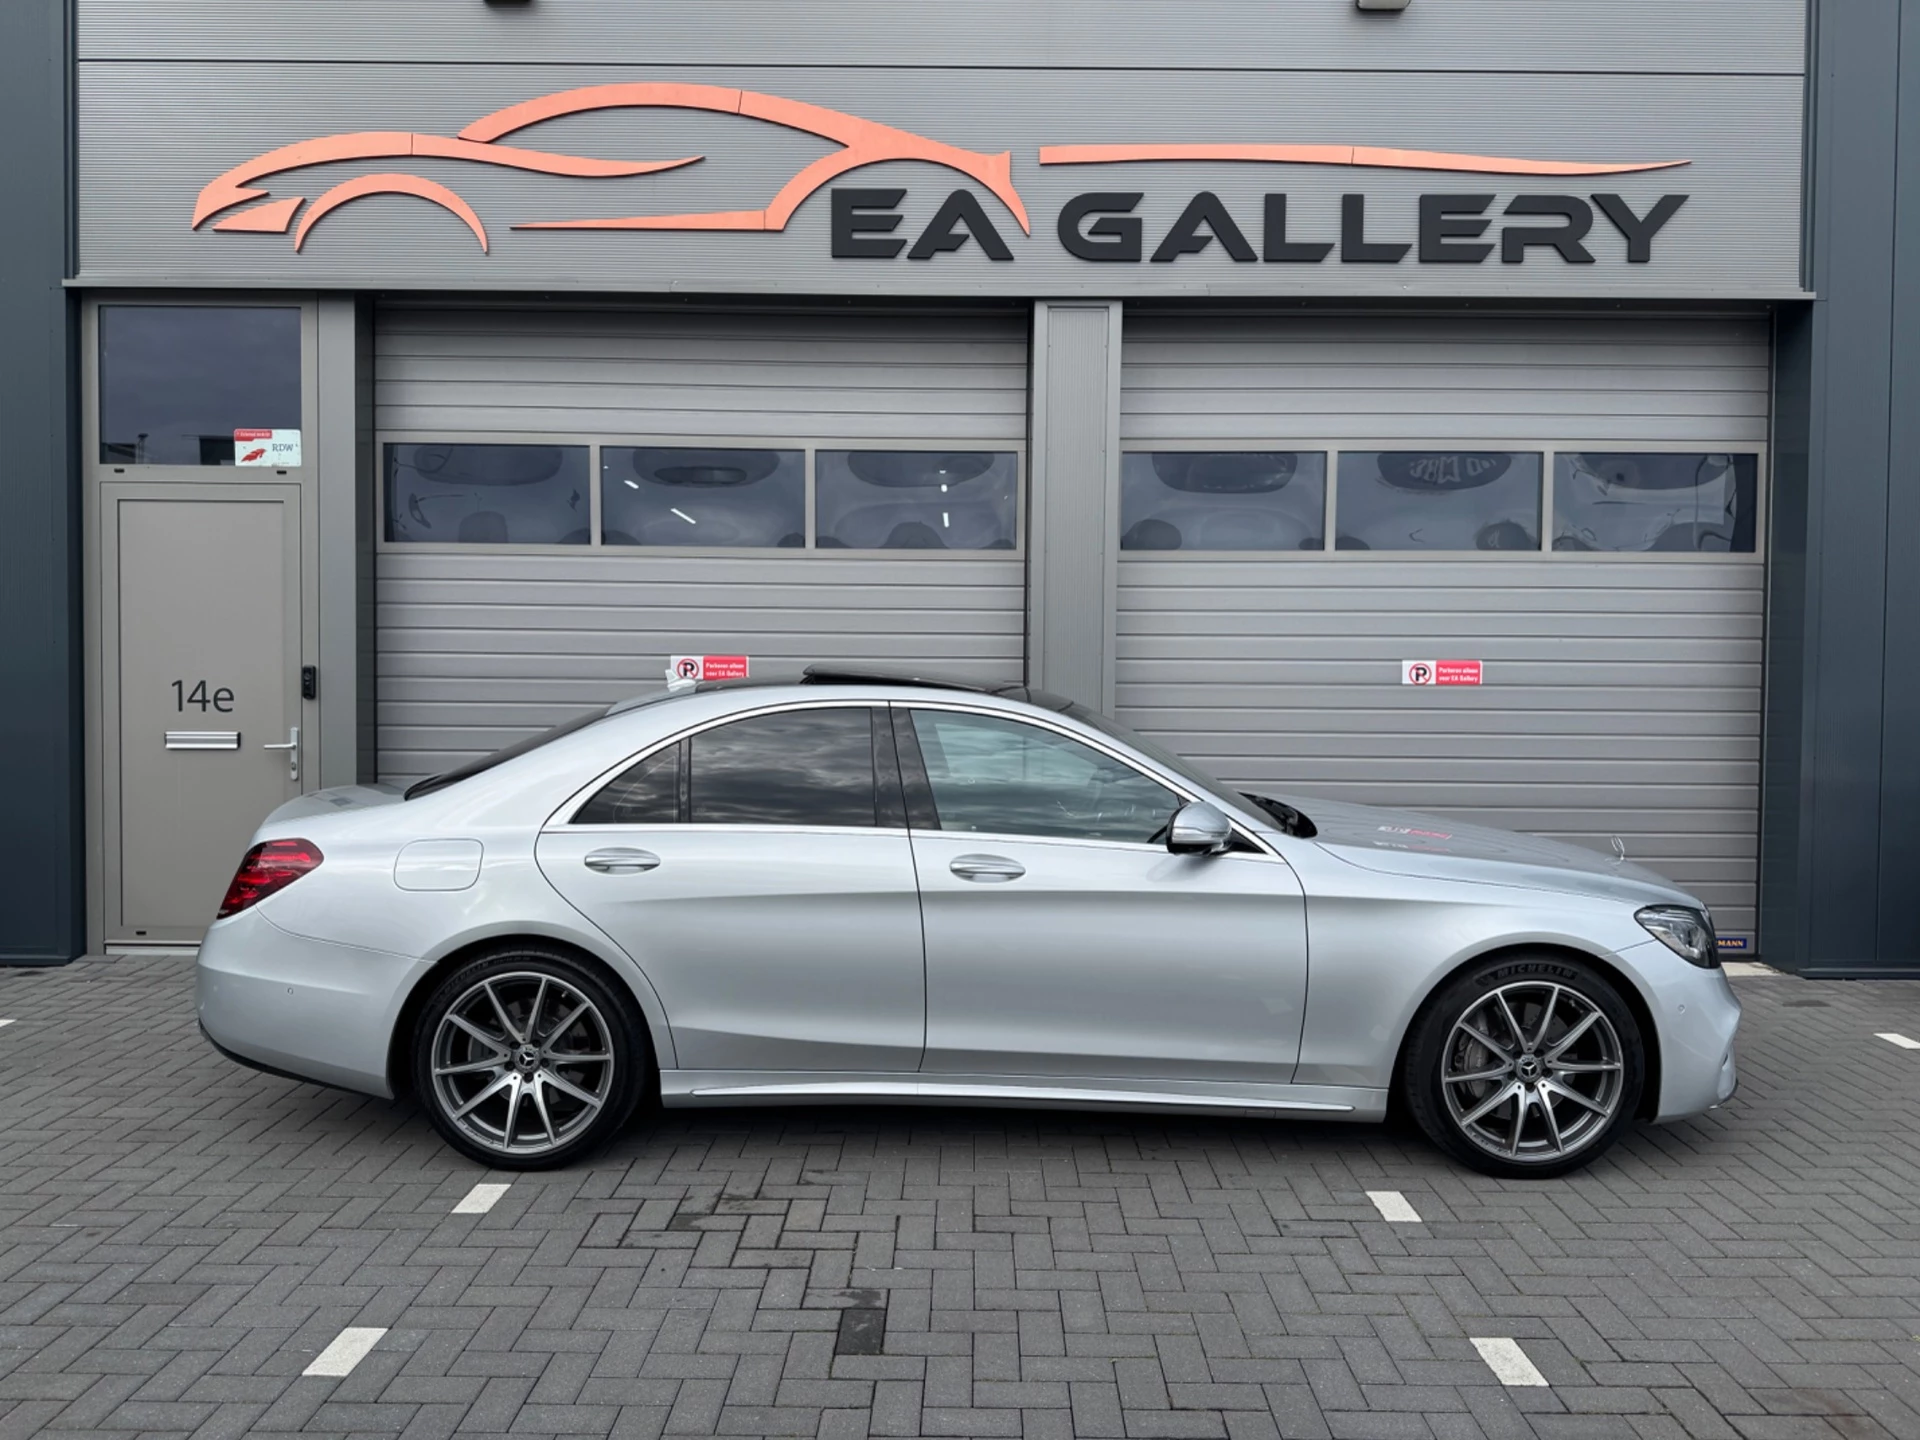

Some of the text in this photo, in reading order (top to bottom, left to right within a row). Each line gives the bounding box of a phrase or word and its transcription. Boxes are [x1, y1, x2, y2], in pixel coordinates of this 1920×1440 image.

[831, 188, 1690, 263] EA GALLERY
[272, 443, 294, 452] RDW
[171, 679, 235, 713] 14e
[1497, 964, 1574, 978] MICHELIN
